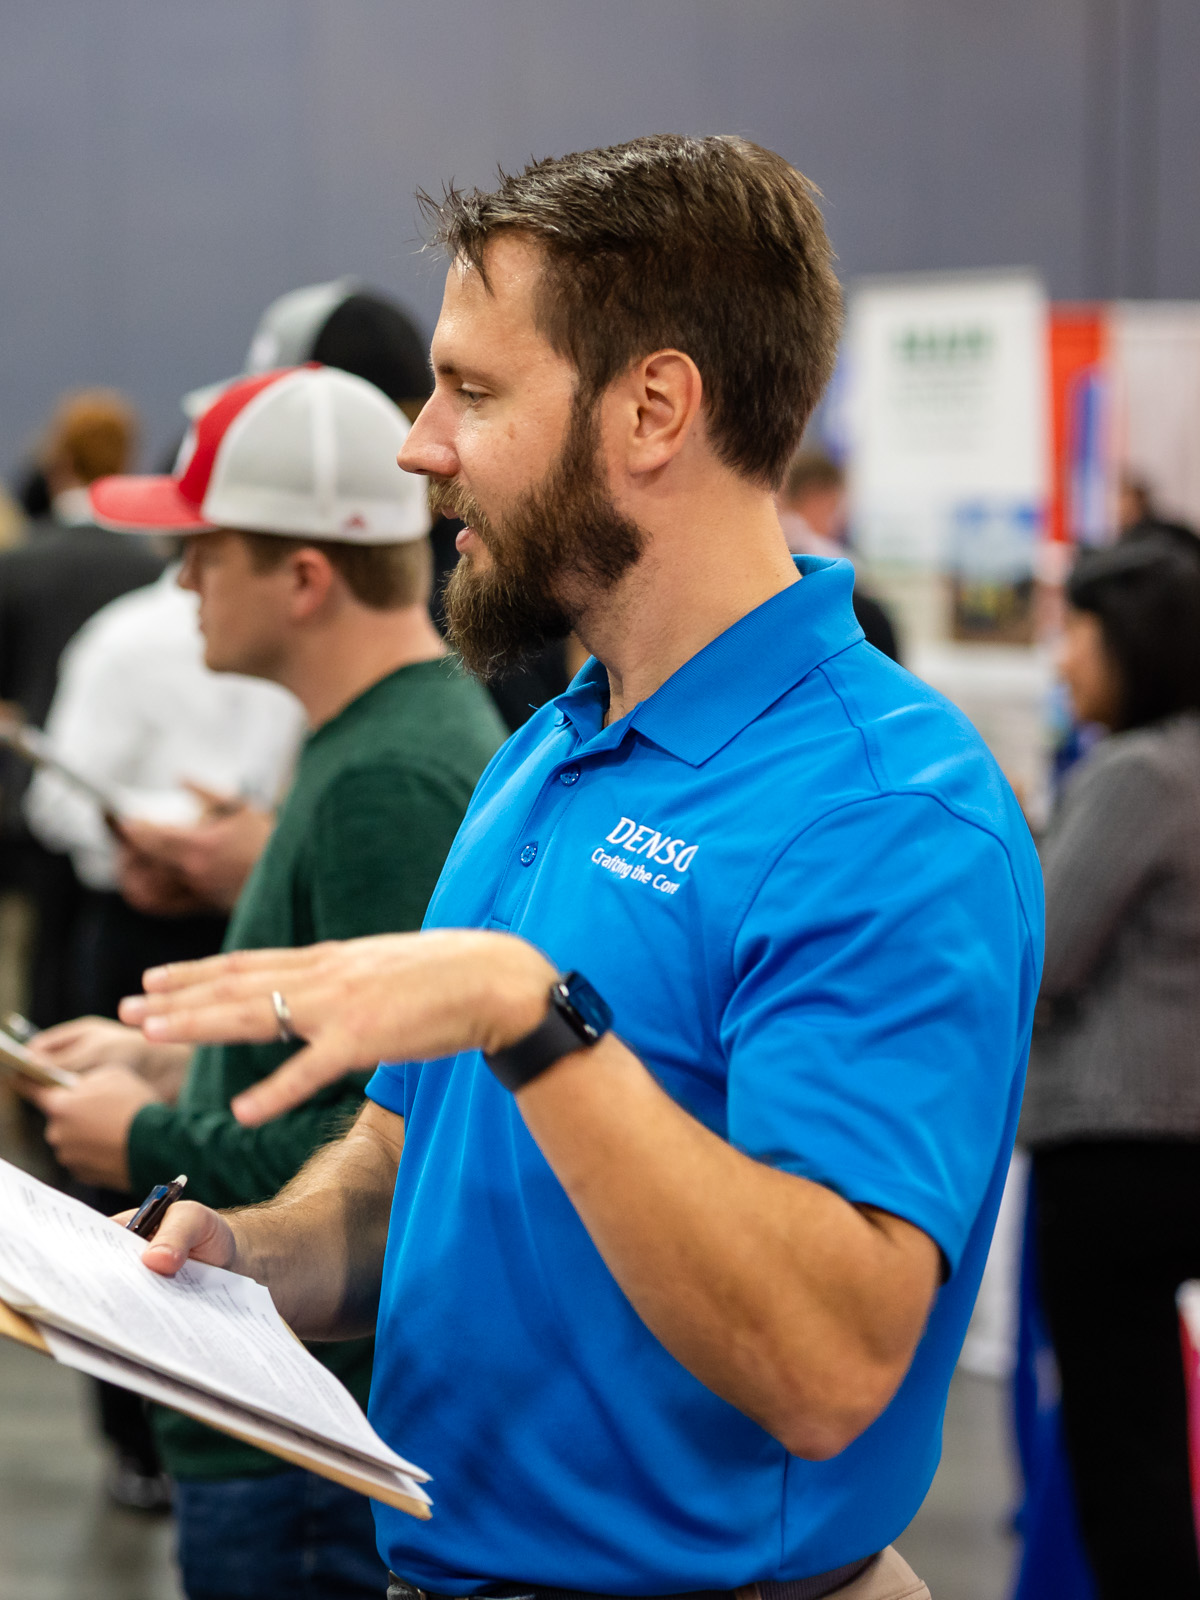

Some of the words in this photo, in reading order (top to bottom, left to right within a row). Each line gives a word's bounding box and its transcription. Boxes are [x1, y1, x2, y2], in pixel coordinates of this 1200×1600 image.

[591, 847, 633, 879] Crafting
[630, 864, 653, 884] the
[605, 816, 699, 872] DENSO
